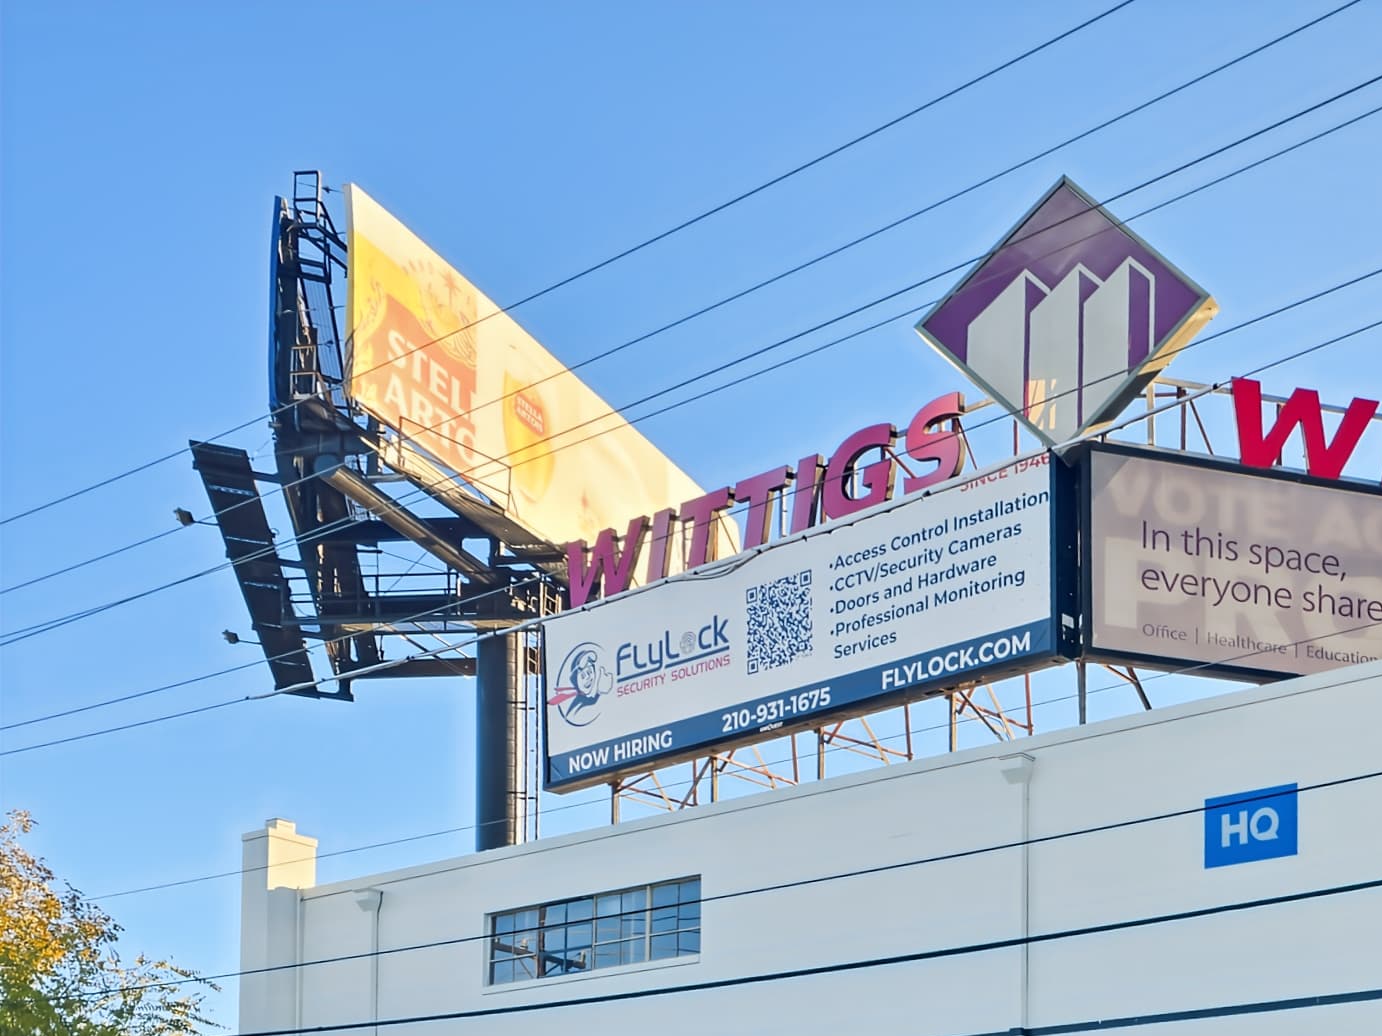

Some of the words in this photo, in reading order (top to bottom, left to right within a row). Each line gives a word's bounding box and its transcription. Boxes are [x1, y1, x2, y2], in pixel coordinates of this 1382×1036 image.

[566, 391, 966, 610] WITTIGS
[833, 543, 887, 571] Access
[890, 518, 949, 551] Control
[953, 489, 1050, 532] Installation
[1141, 520, 1170, 553] In
[1180, 527, 1239, 563] this
[1248, 541, 1347, 582] space,
[834, 547, 944, 593] CCTV/Security
[948, 522, 1022, 556] Cameras
[835, 591, 880, 616] Doors
[884, 577, 913, 600] and
[917, 553, 997, 590] Hardware
[835, 593, 929, 637] Professional
[933, 569, 1026, 607] Monitoring
[1140, 564, 1293, 610] everyone
[833, 630, 897, 659] Services
[881, 631, 1031, 690] FLYLOCK.COM
[1142, 623, 1188, 641] Office
[1207, 631, 1288, 655] Healthcare
[616, 673, 667, 698] SECURITY
[671, 654, 731, 682] SOLUTIONS
[721, 686, 831, 732] 210-931-1675
[568, 746, 610, 774] NOW
[613, 730, 673, 763] HIRING
[1221, 806, 1280, 848] HQ
